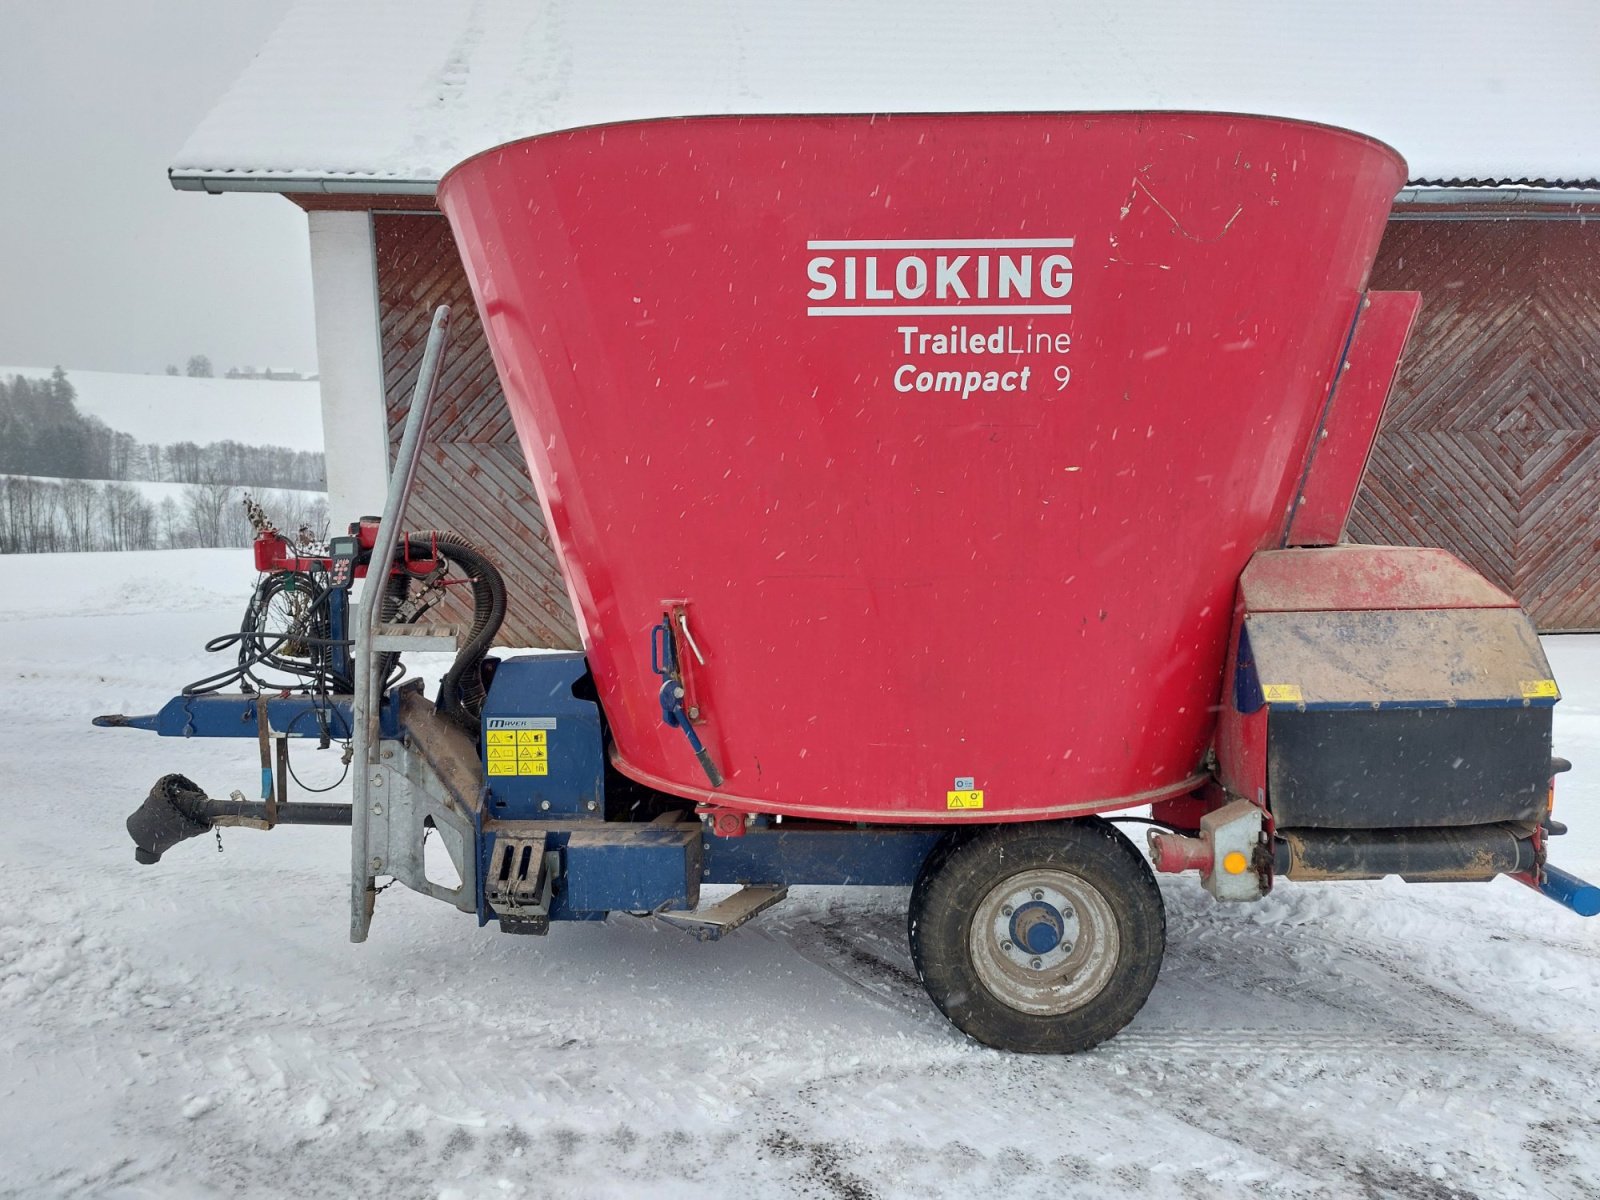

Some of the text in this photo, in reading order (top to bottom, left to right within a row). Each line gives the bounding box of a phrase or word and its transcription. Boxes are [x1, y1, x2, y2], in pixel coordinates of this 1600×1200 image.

[806, 254, 1073, 300] SILOKING
[897, 325, 1071, 354] TrailedLine
[893, 364, 1071, 400] Compact 9
